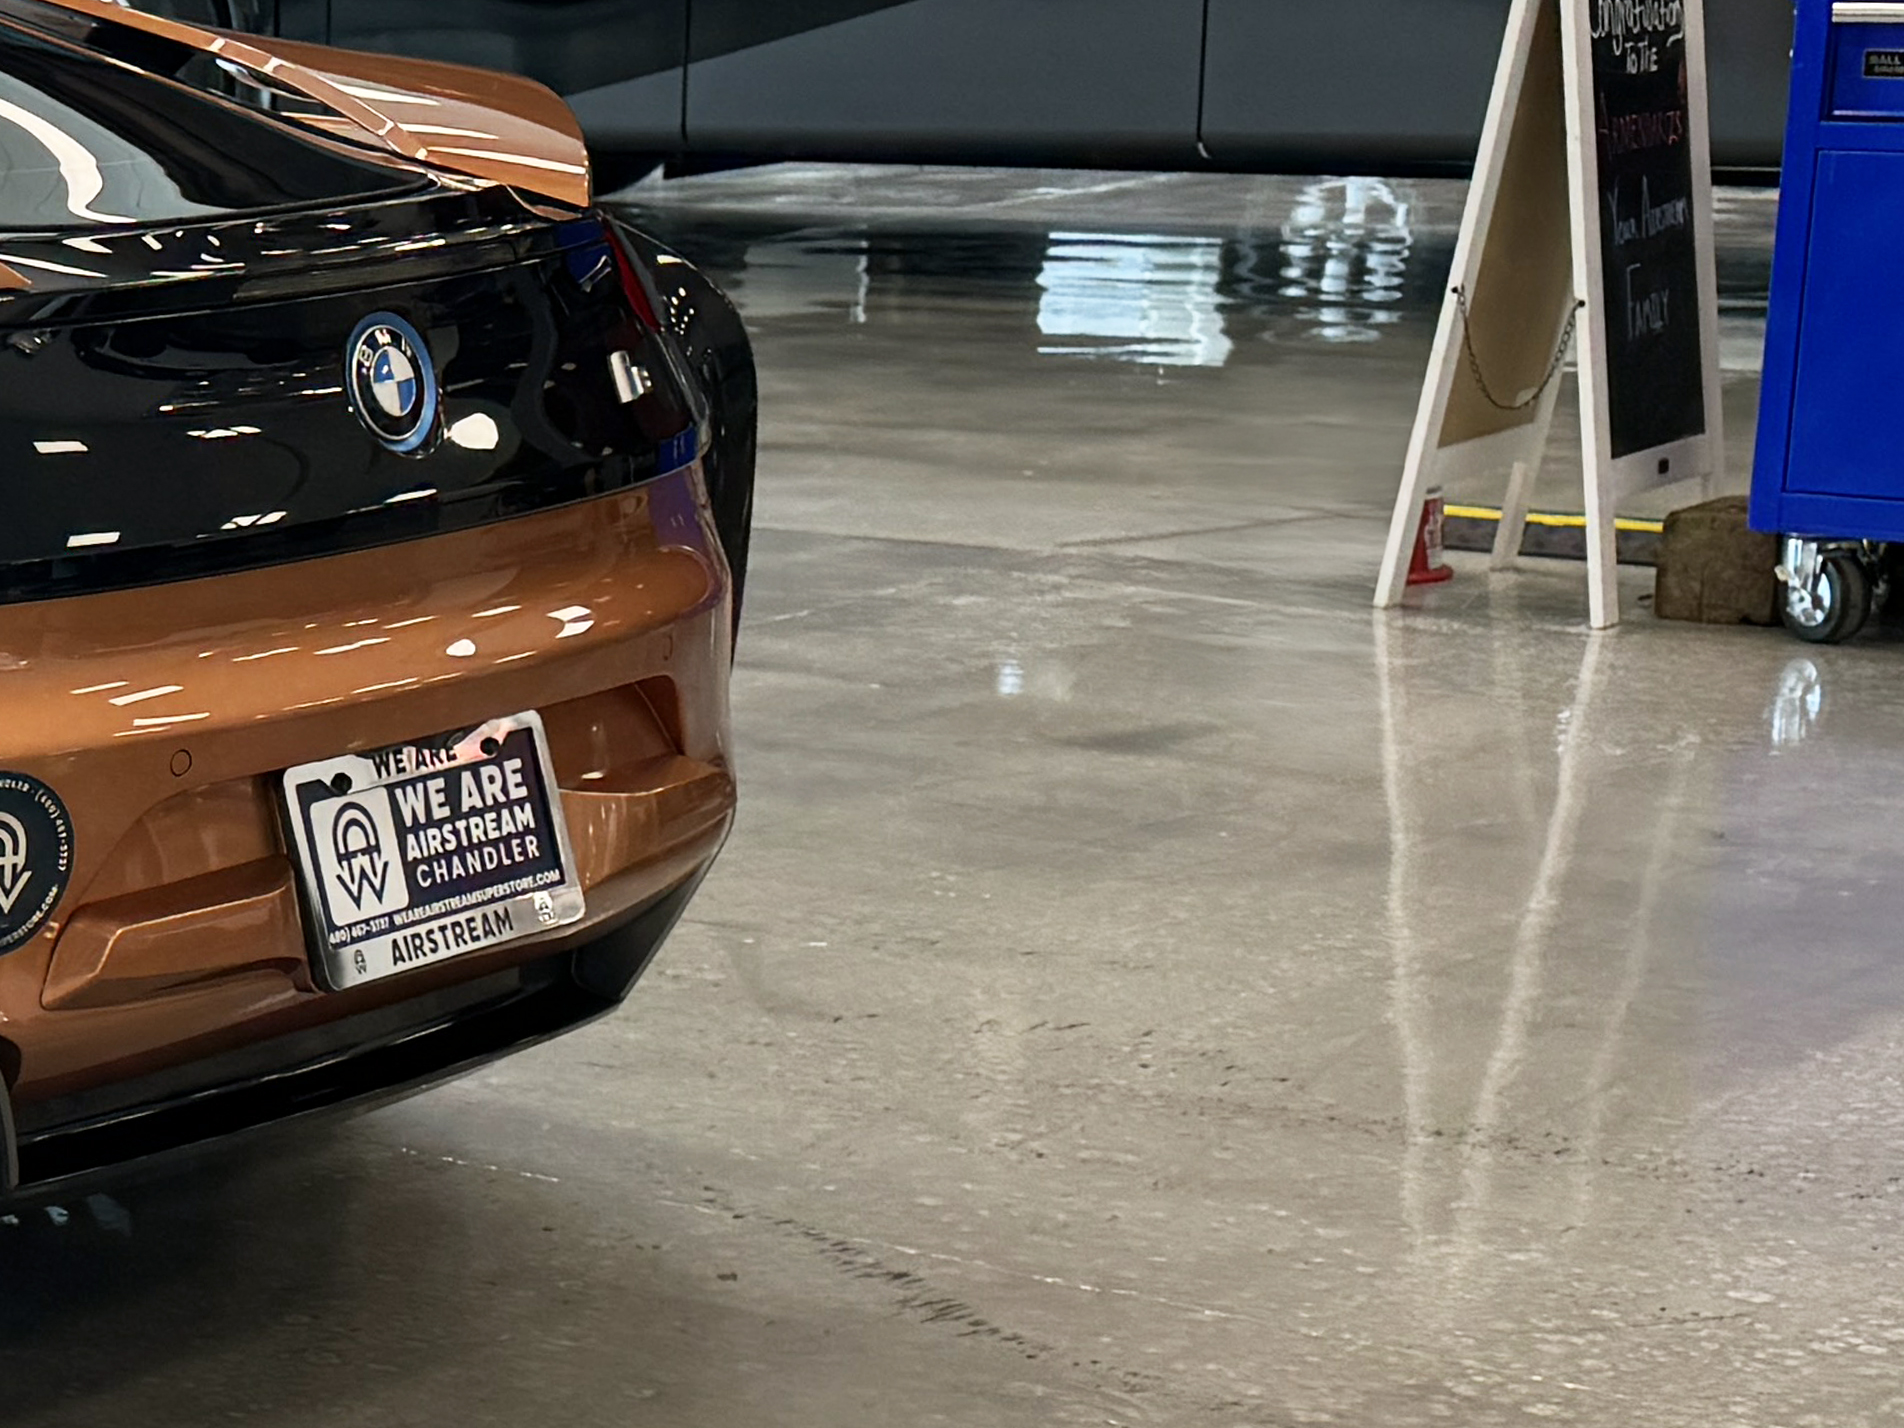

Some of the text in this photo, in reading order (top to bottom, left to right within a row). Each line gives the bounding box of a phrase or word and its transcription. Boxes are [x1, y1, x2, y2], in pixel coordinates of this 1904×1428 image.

[372, 747, 458, 779] WE ARE
[394, 757, 529, 828] WE ARE
[405, 801, 536, 862] AIRSTREAM
[416, 834, 541, 888] CHANDLER
[391, 905, 514, 966] AIRSTREAM
